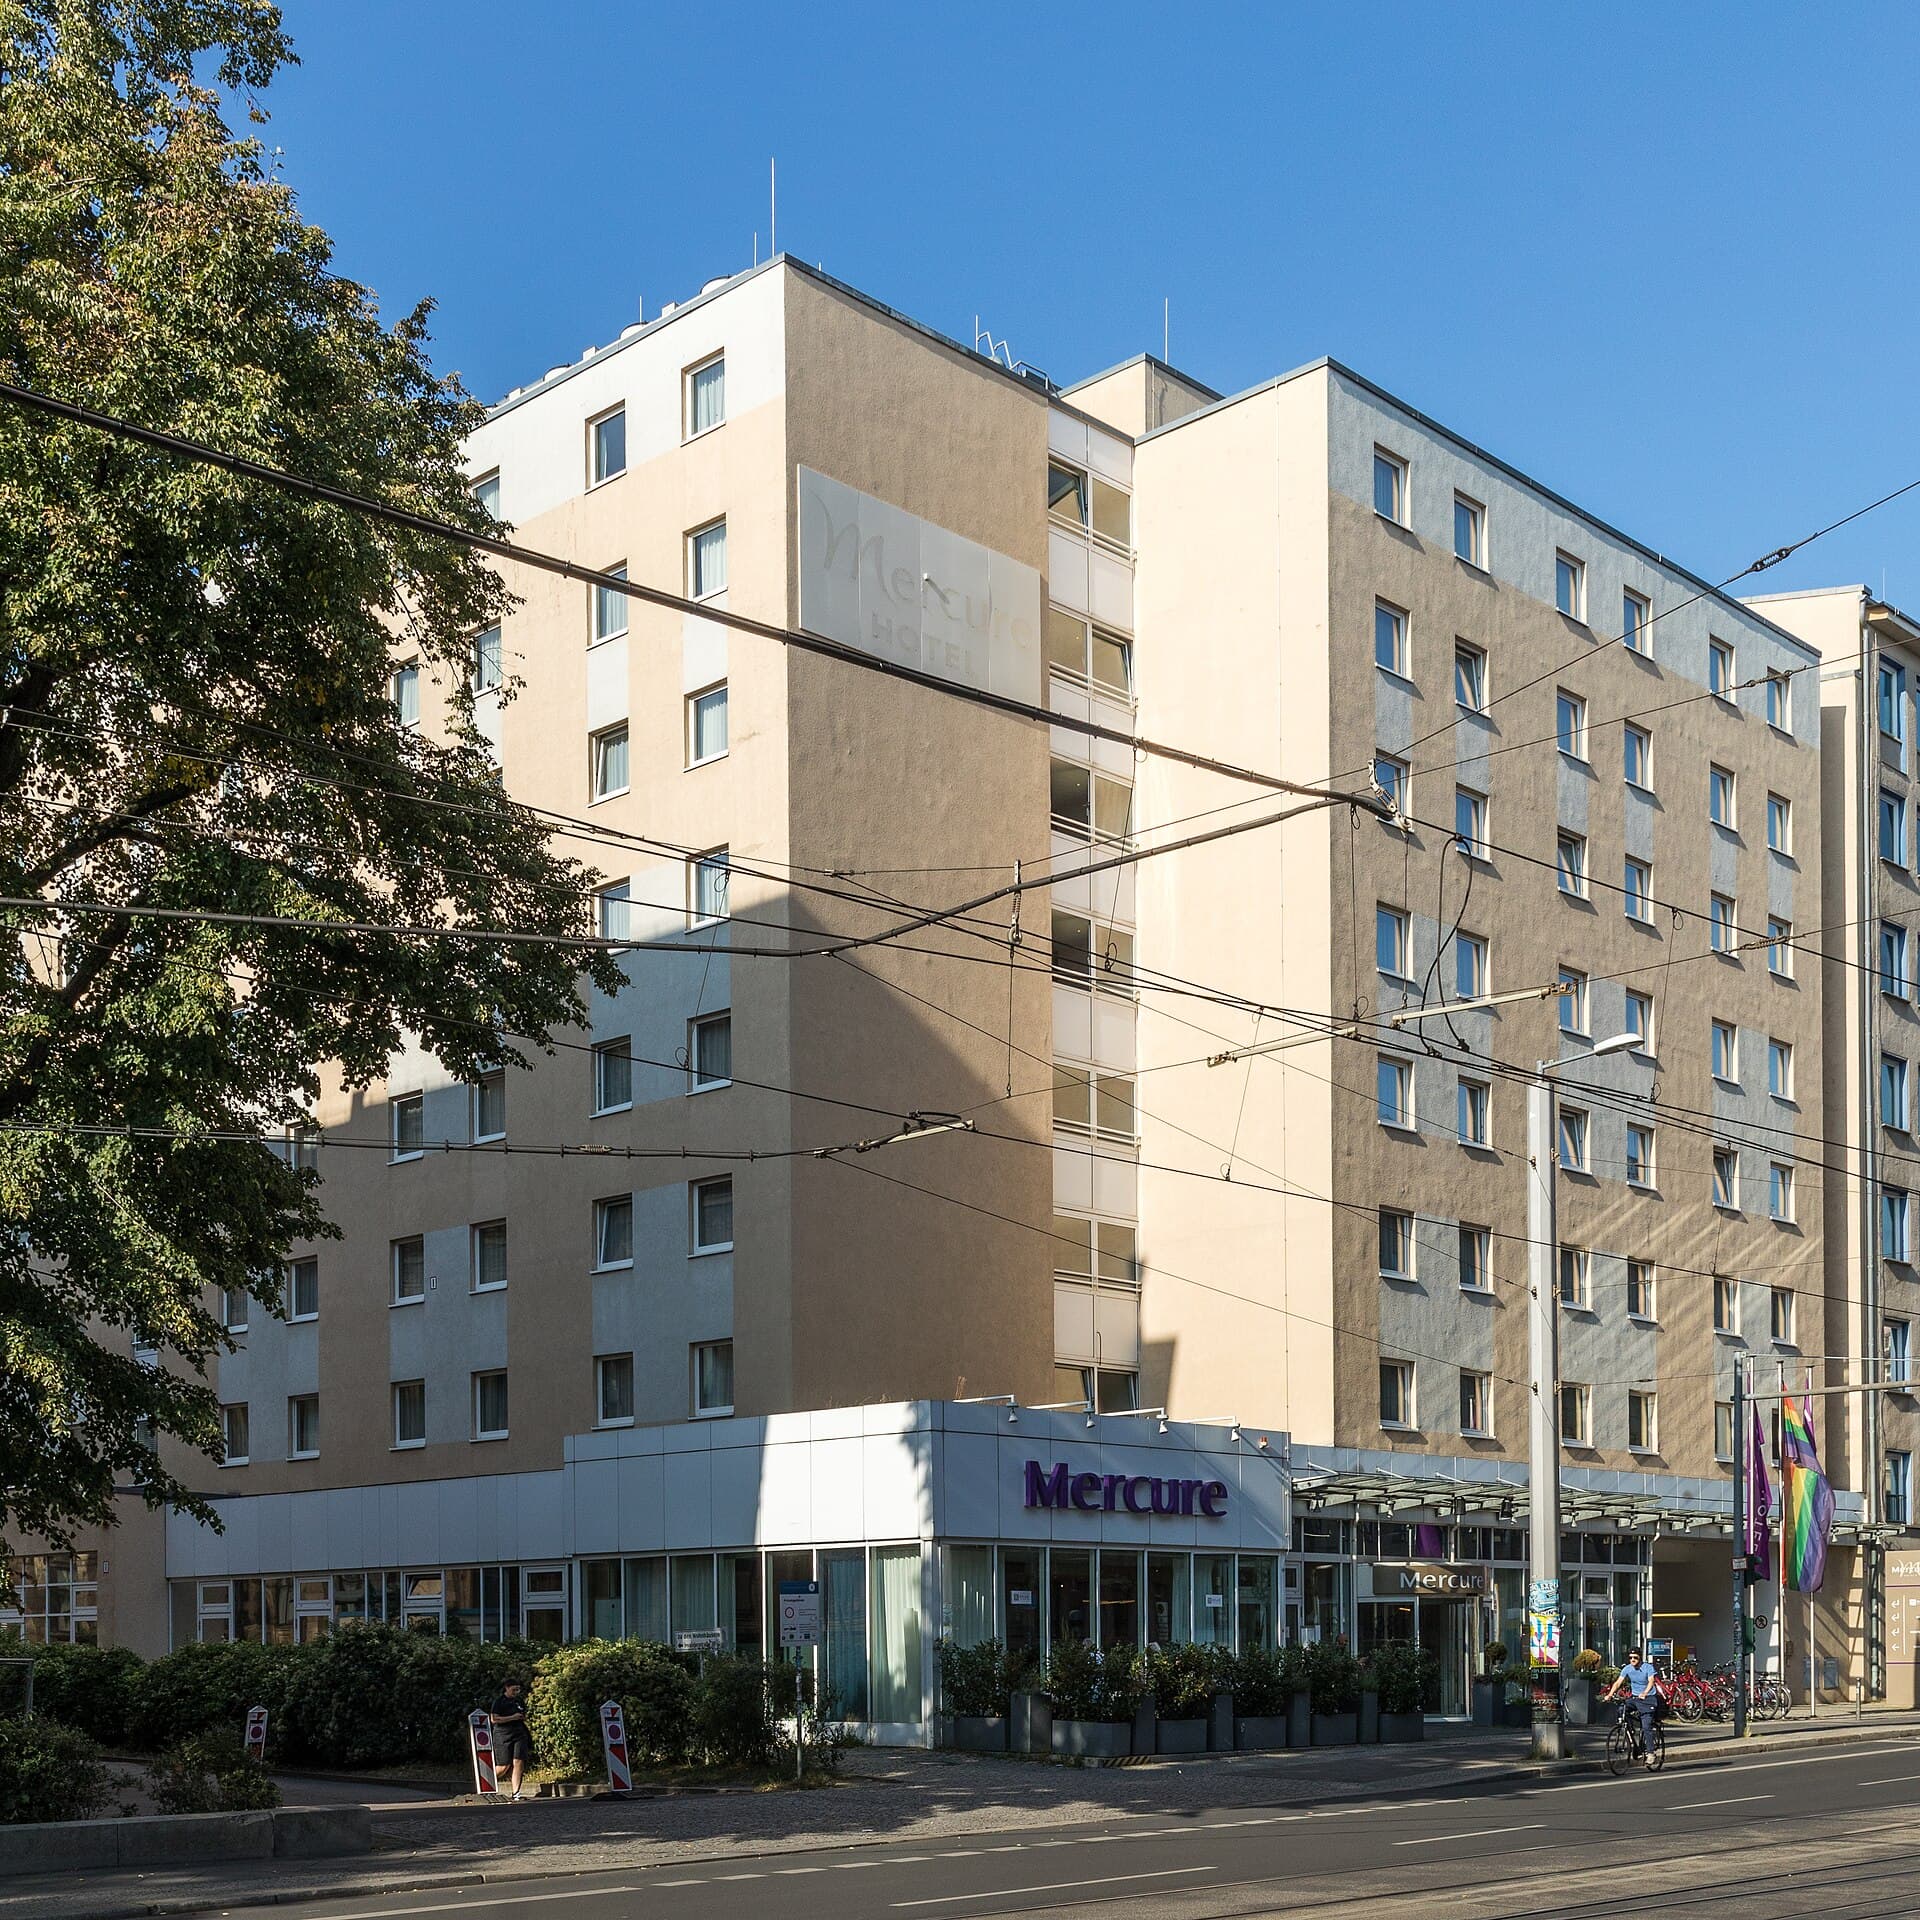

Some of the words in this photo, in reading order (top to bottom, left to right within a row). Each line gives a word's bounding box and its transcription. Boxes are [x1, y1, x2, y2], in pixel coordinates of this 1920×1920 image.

[808, 489, 1034, 648] Mercure
[871, 608, 975, 674] HOTEL
[1024, 1460, 1228, 1517] Mercure
[1400, 1572, 1484, 1589] Mercure
